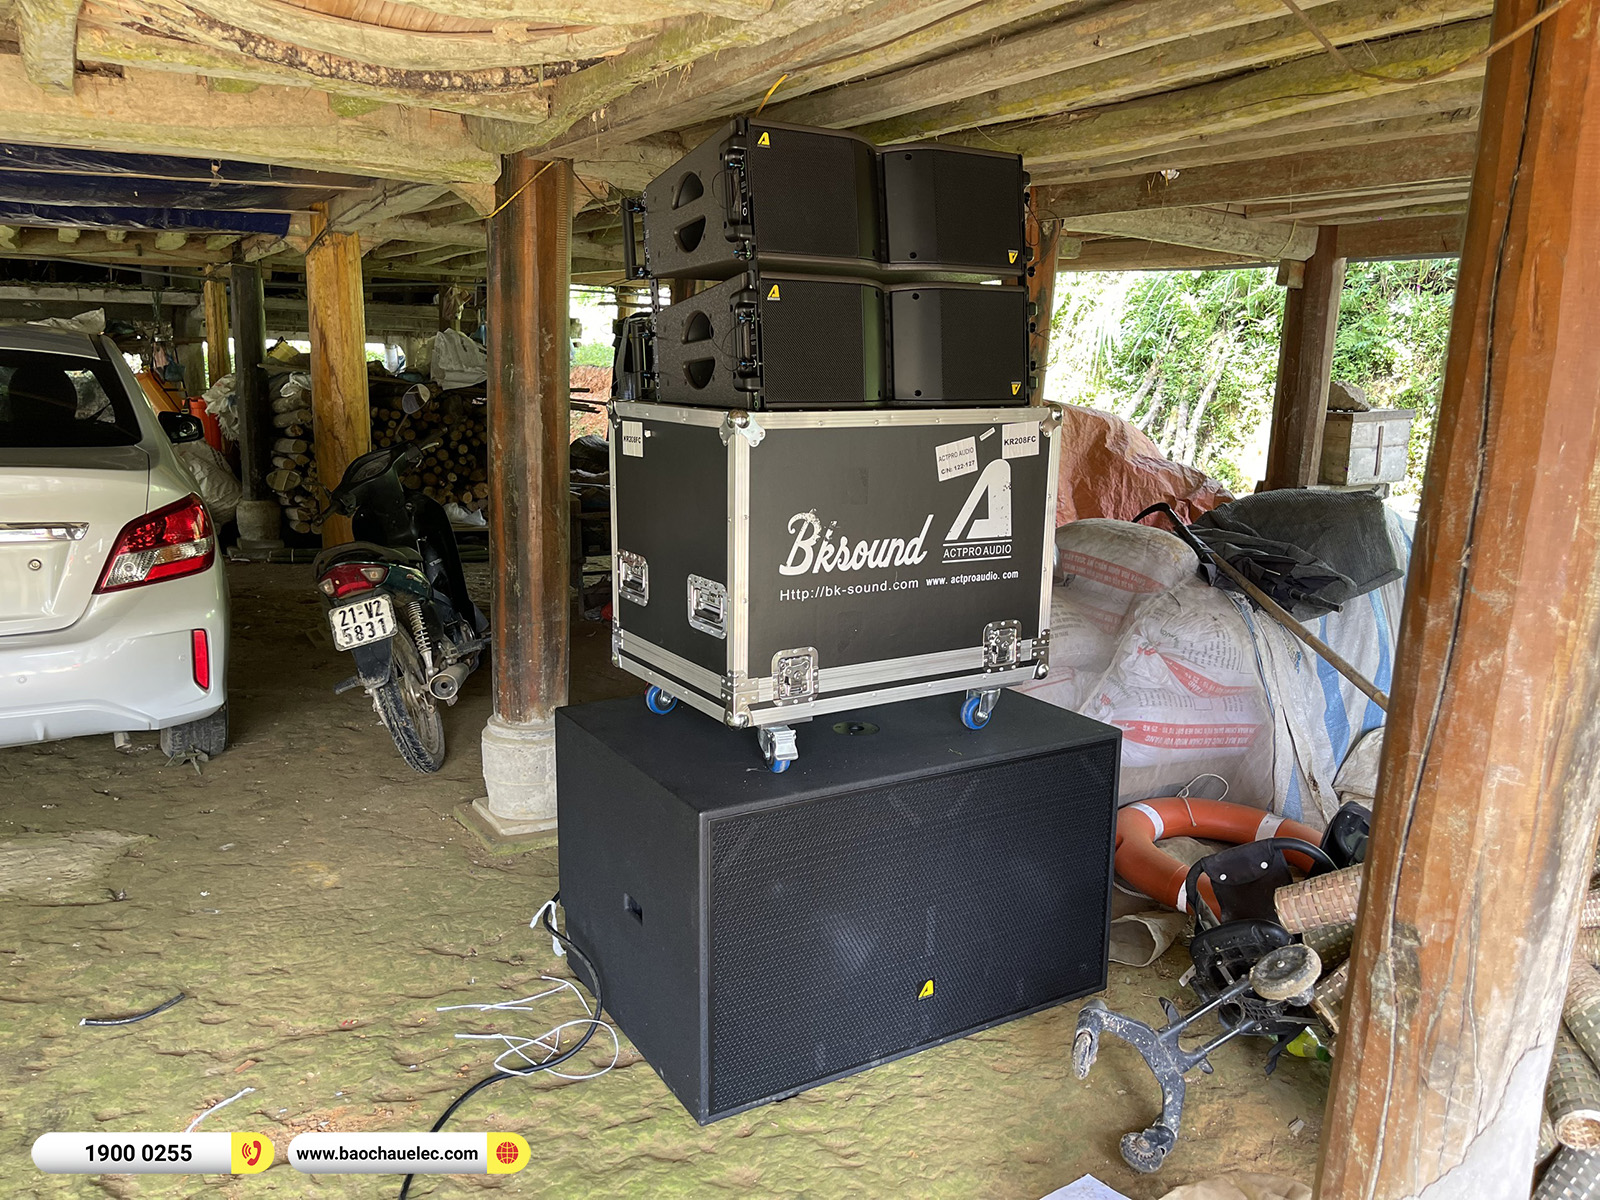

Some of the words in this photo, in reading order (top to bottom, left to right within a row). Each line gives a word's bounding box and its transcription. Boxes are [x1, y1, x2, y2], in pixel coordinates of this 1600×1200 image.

[1003, 435, 1037, 446] KR208FC
[938, 450, 958, 462] ACTPRO
[958, 446, 975, 457] AUDIO
[778, 508, 934, 576] Bksound
[1002, 570, 1019, 580] com
[779, 577, 919, 602] Http://bk-sound.com
[338, 600, 384, 627] 21-V2
[342, 618, 387, 645] 5831
